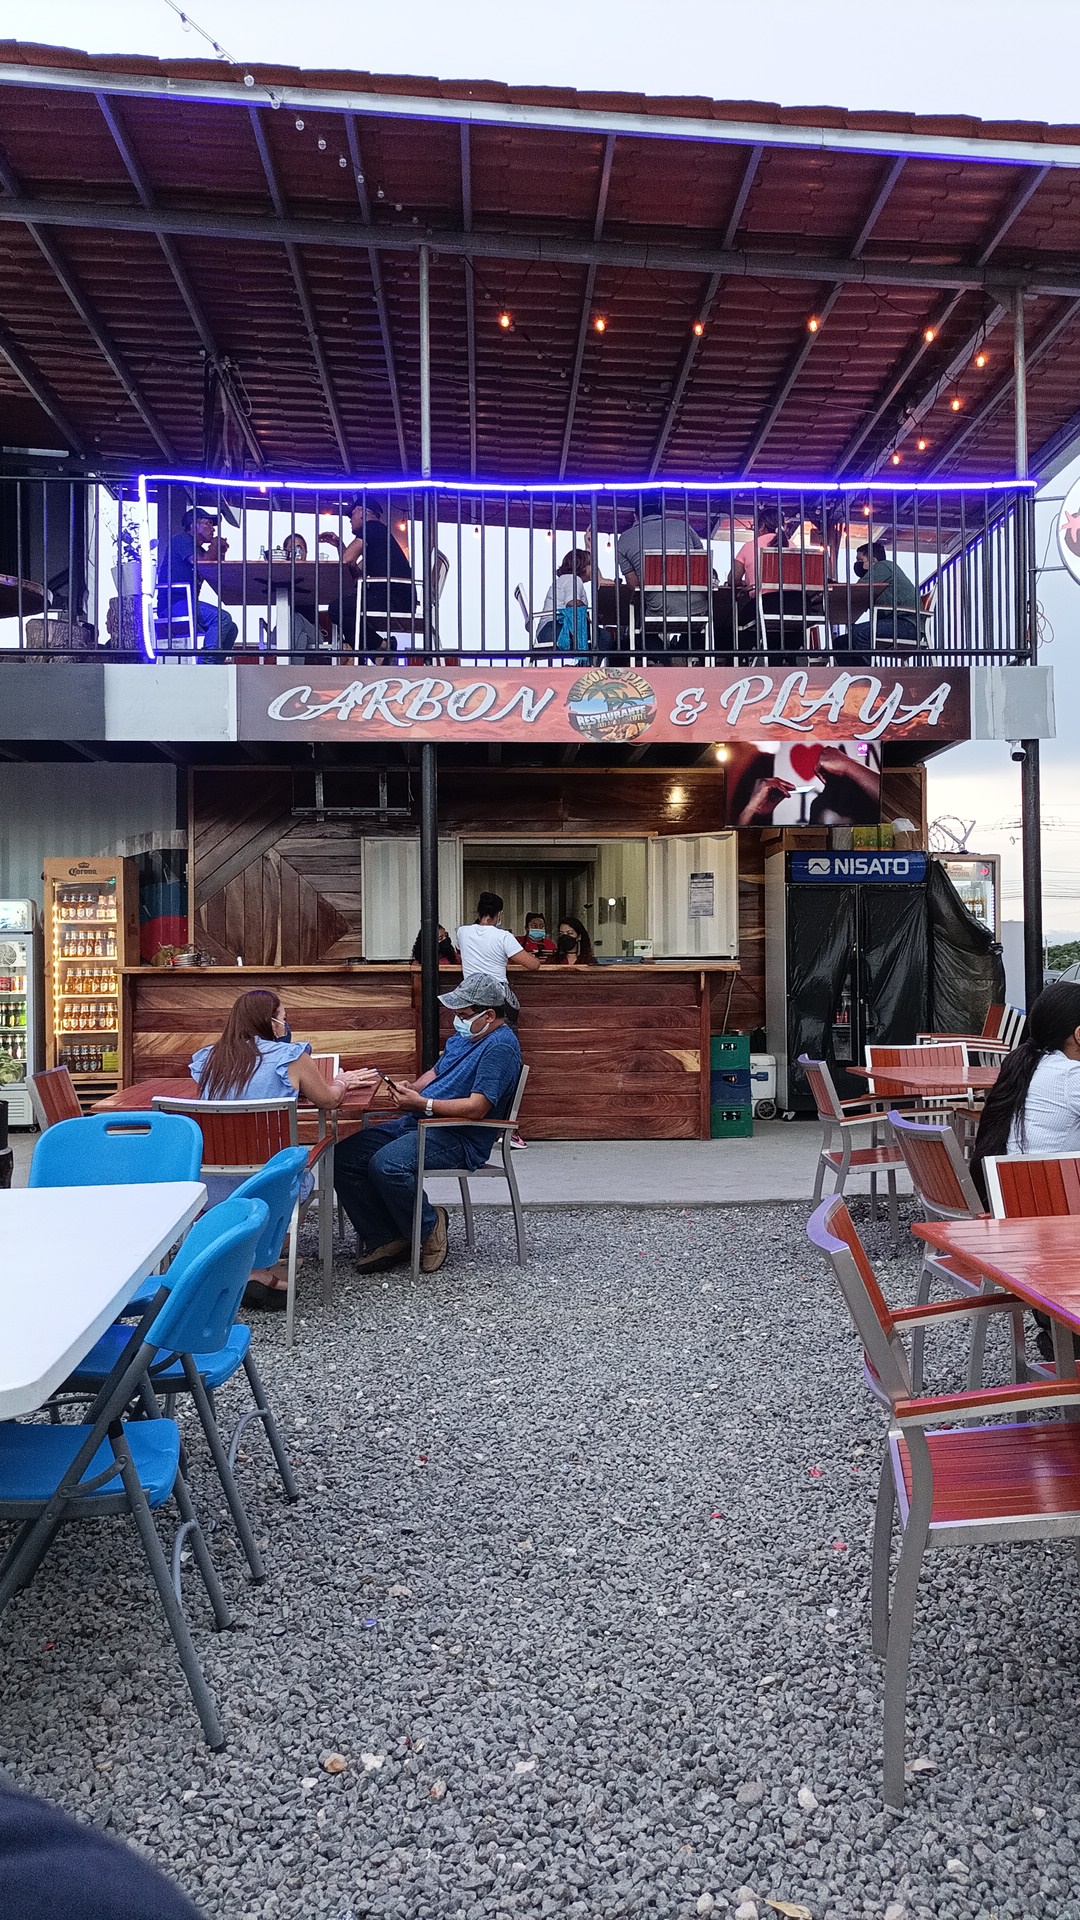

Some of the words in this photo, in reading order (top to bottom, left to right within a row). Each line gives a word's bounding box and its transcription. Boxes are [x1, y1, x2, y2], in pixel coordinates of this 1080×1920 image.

[267, 677, 555, 727] CARBON
[669, 687, 708, 726] &
[719, 671, 951, 741] PLAYA
[576, 705, 647, 726] RESTAURANTE
[68, 867, 98, 877] Corona
[834, 858, 909, 875] NISATO
